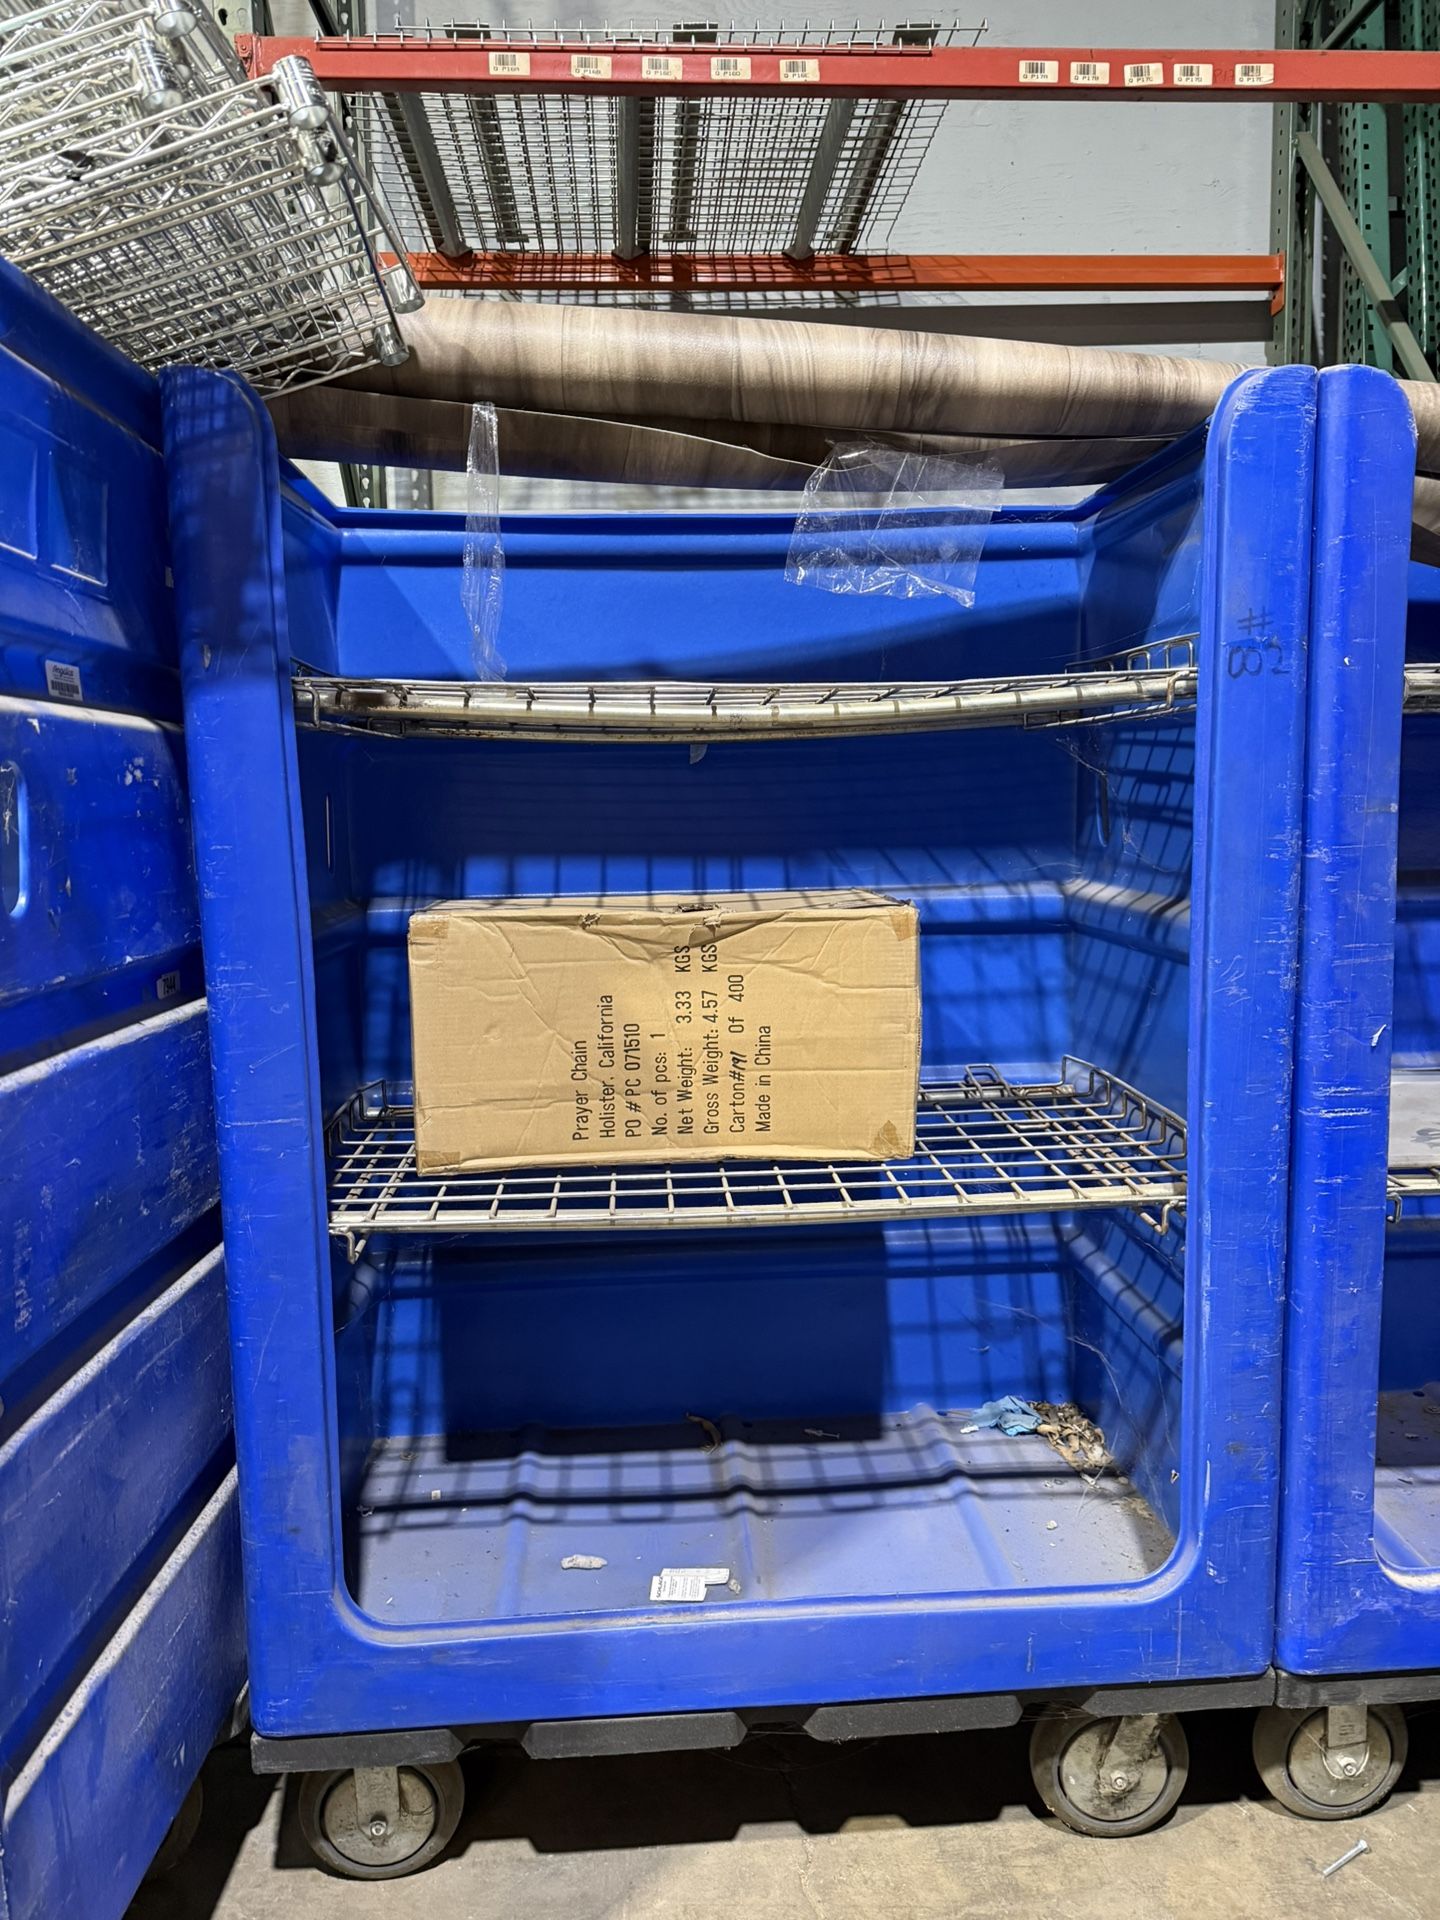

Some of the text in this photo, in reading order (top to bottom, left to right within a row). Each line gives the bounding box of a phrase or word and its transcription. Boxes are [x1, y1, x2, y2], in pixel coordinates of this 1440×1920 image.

[597, 995, 614, 1068] California
[727, 975, 744, 1003] 400
[623, 1023, 641, 1071] 071510
[674, 945, 696, 1135] Net Weight: 3.33 KGS
[701, 944, 722, 1134] Gross Weight: 4.57 KGS
[754, 1025, 771, 1132] Made in China
[571, 1040, 593, 1141] Prayer Chain
[625, 1078, 641, 1097] PC
[650, 1032, 671, 1136] No. of pcs: 1
[625, 1119, 641, 1137] PO
